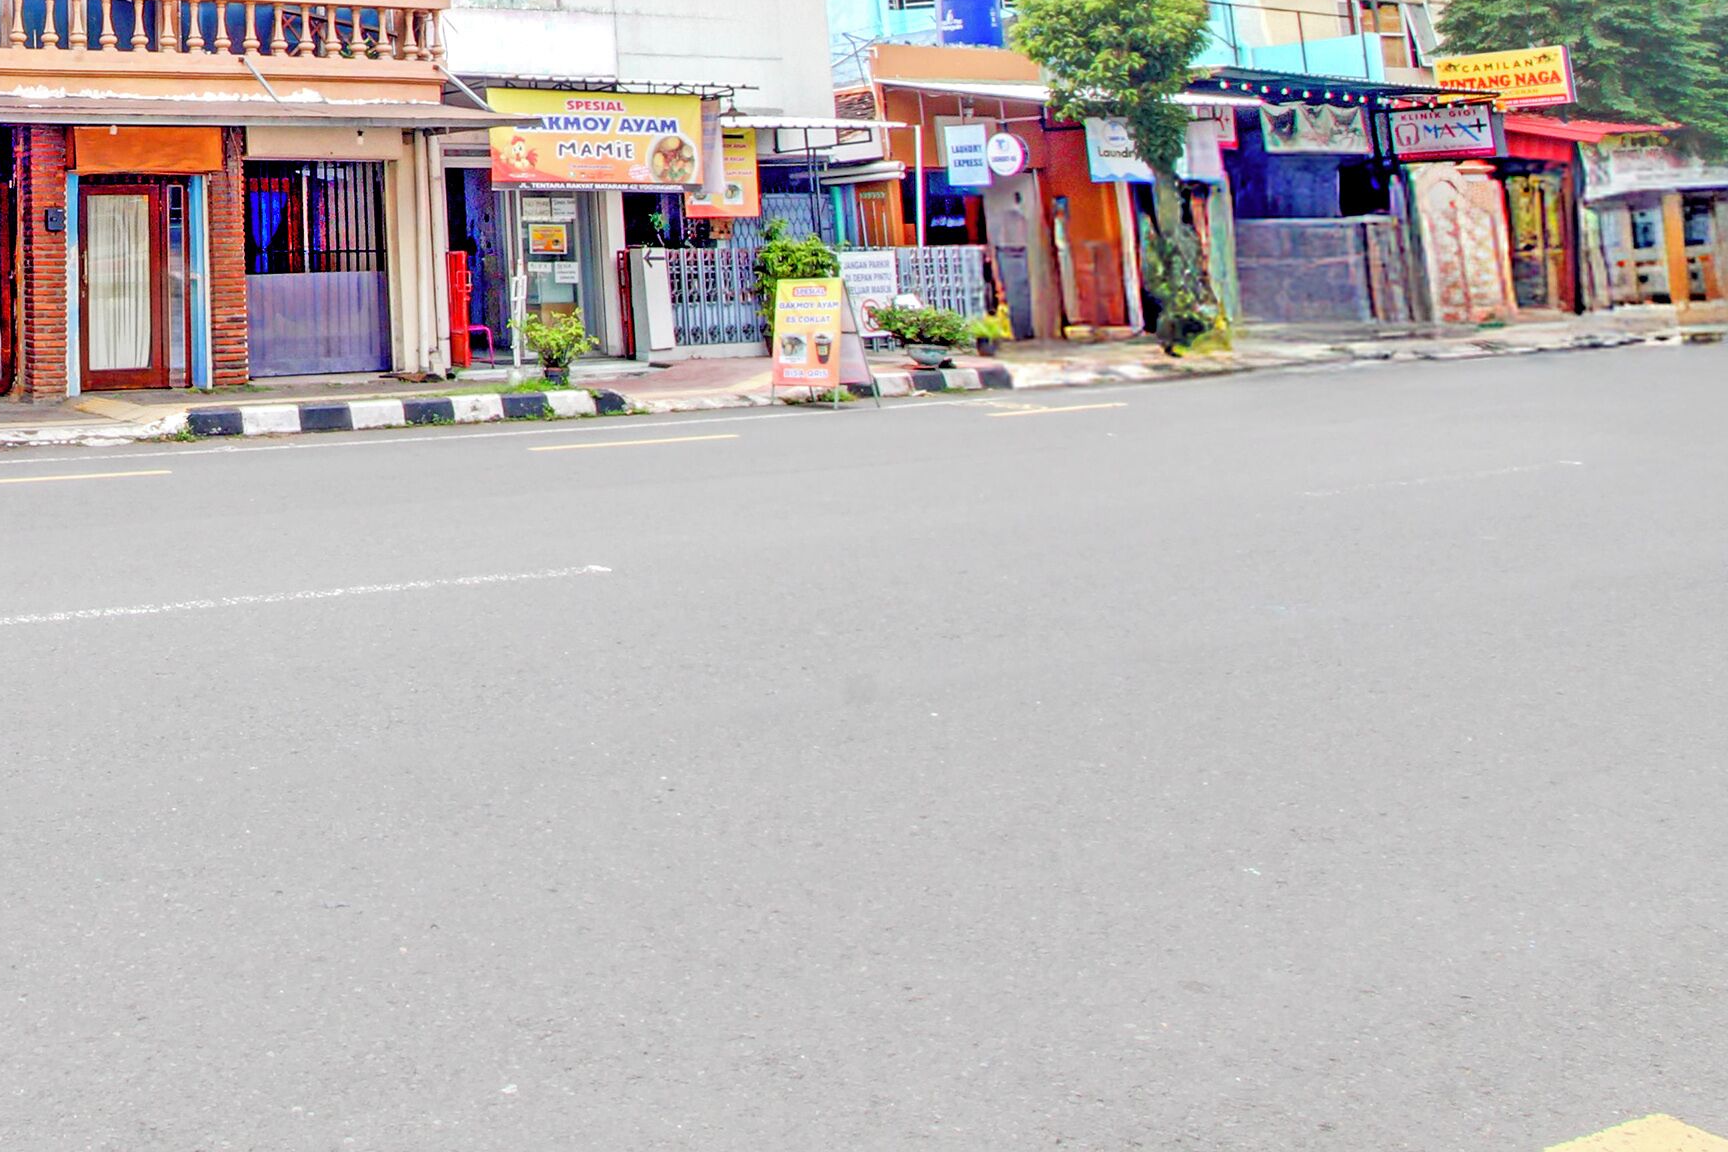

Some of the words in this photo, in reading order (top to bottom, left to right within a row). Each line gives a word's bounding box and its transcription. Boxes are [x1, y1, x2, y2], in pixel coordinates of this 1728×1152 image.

[1462, 59, 1533, 73] CAMILAN
[1515, 70, 1562, 85] NAGA
[566, 100, 625, 112] SPESIAL
[1400, 112, 1441, 122] KLINIK
[1448, 109, 1477, 118] GIGI
[618, 117, 678, 134] AYAM
[951, 144, 982, 154] LAUNDRY
[953, 158, 983, 168] EXPRESS
[532, 182, 565, 190] TENTARA
[595, 183, 628, 191] MATARAM
[848, 286, 869, 295] ELUAR
[817, 301, 839, 309] AYAM
